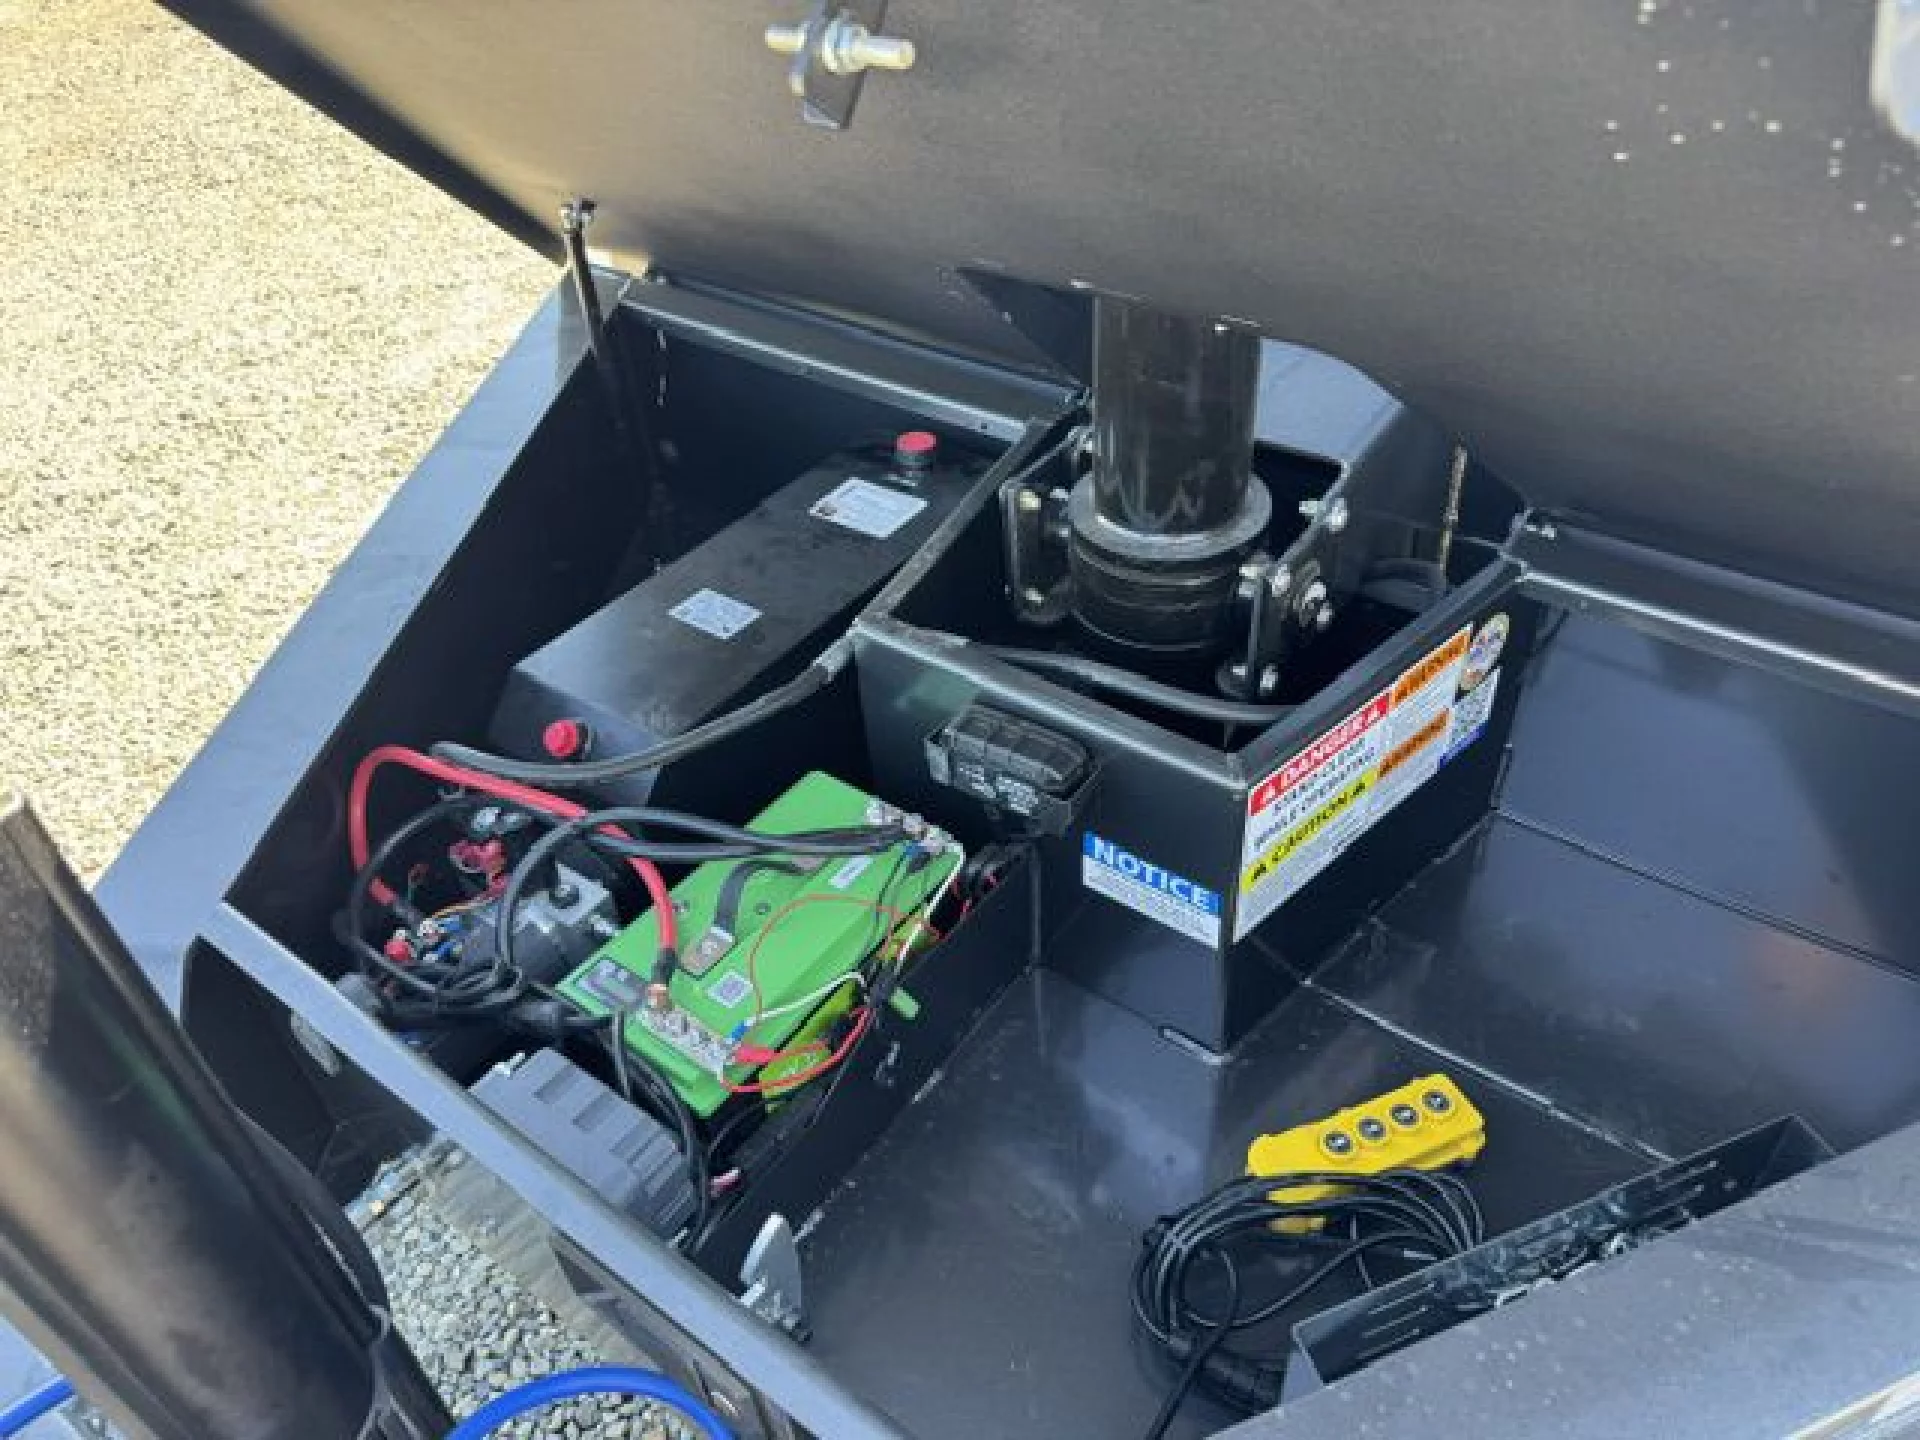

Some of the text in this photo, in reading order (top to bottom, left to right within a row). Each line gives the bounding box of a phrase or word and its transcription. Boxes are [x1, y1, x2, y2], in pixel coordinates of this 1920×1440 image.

[1281, 716, 1366, 788] DANGER
[1271, 792, 1348, 863] CAUTION
[1094, 836, 1210, 910] NOTICE
